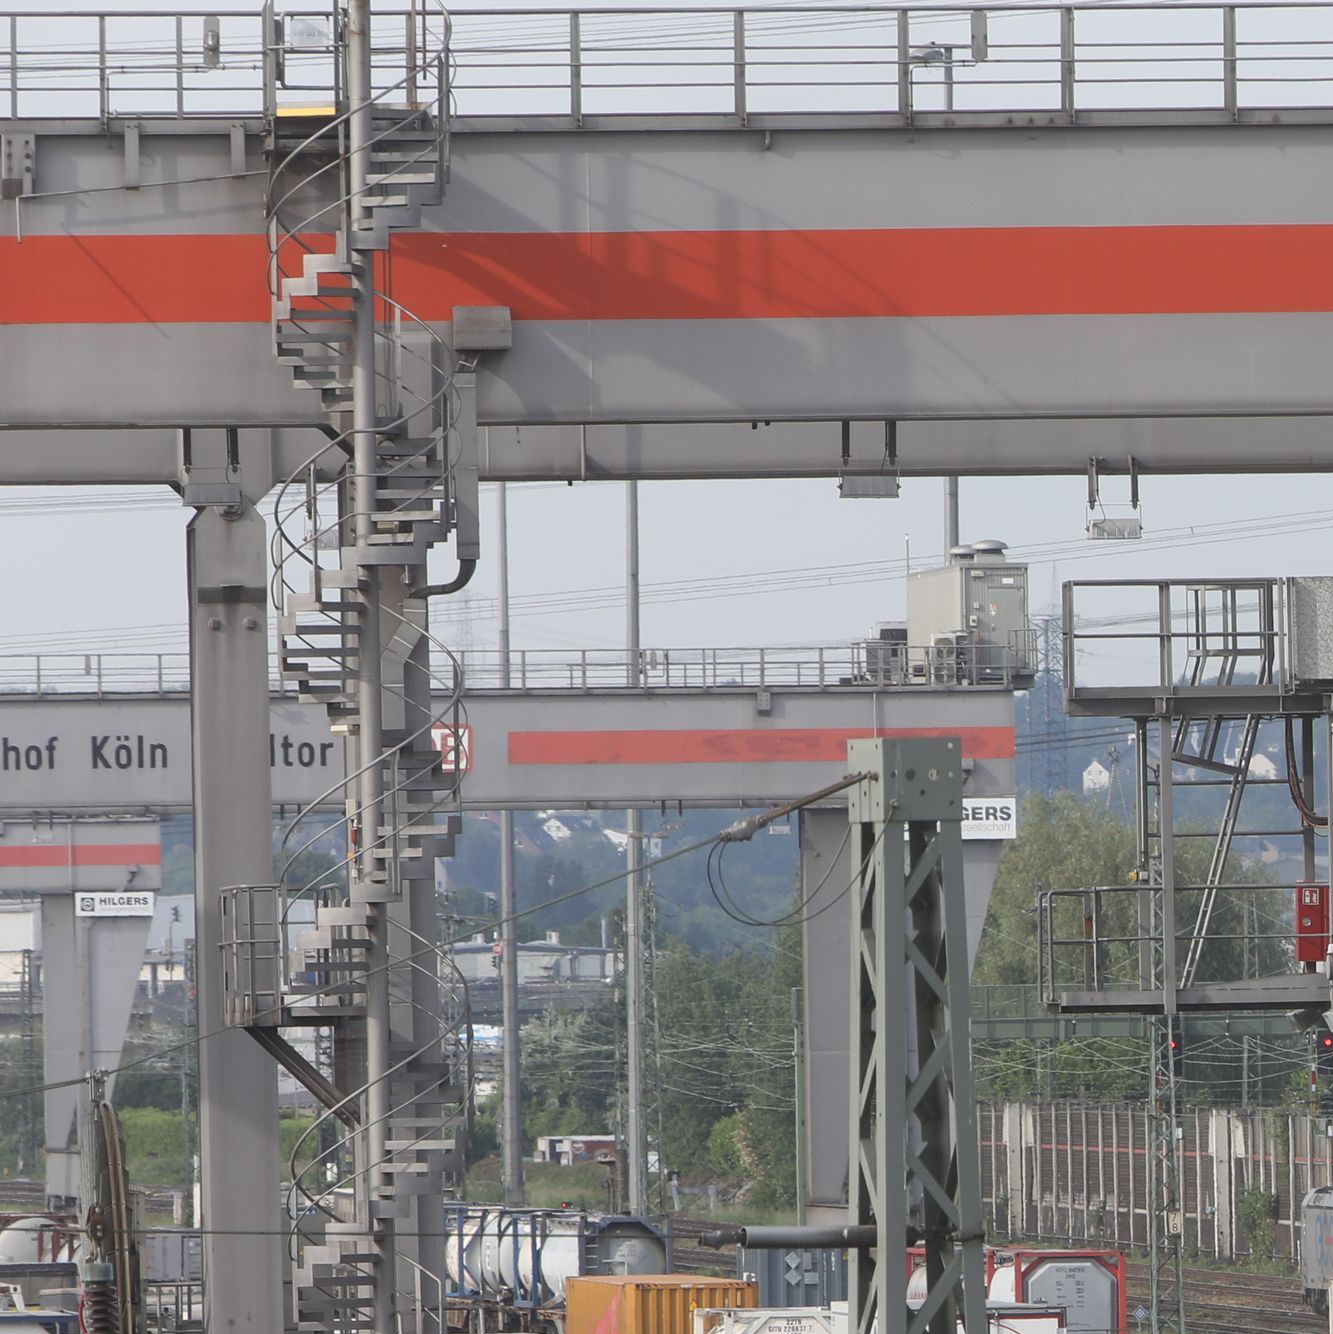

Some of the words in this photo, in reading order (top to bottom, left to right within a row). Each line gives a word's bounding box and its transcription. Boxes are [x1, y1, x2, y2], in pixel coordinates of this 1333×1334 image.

[91, 734, 168, 769] Köln
[962, 805, 1012, 821] GERS
[98, 895, 149, 907] HILGERS
